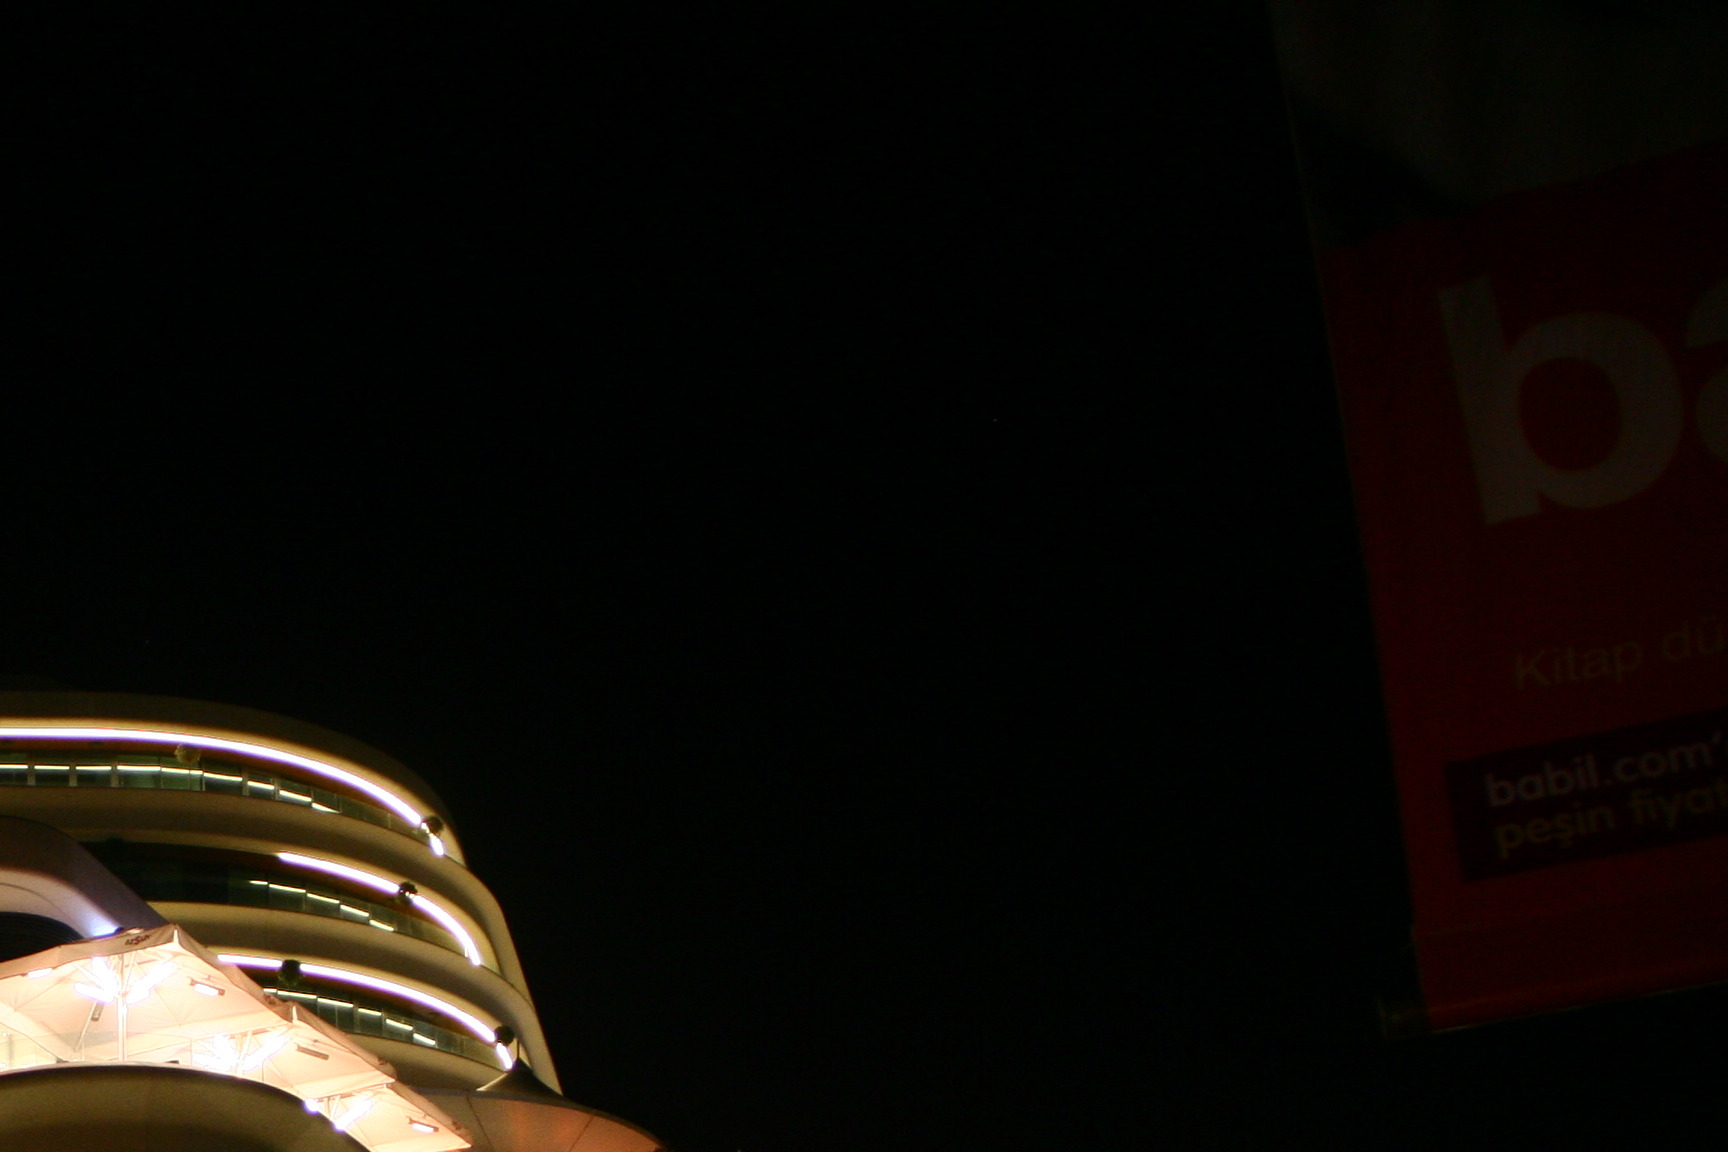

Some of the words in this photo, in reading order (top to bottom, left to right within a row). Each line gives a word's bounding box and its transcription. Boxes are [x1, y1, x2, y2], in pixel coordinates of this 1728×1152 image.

[1511, 640, 1645, 691] Kitap
[1484, 731, 1728, 808] babil.com'
[1492, 801, 1616, 861] peşin
